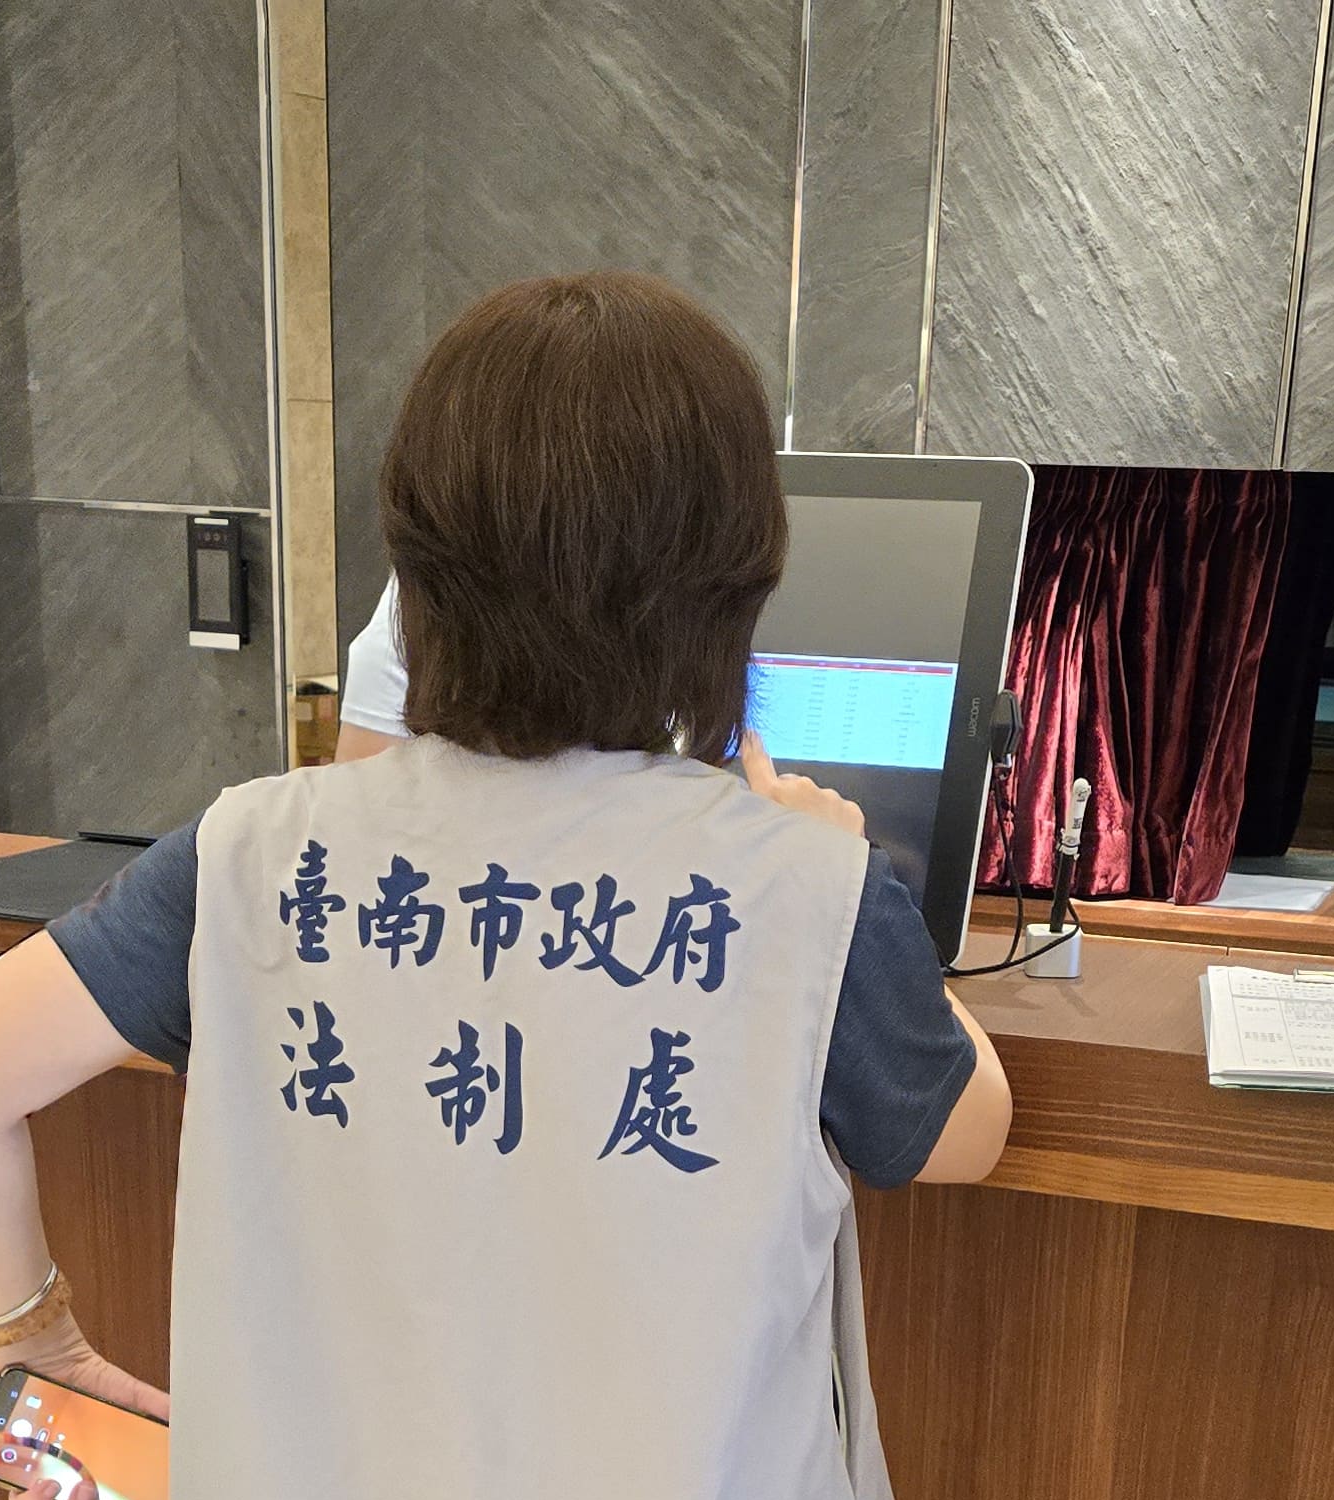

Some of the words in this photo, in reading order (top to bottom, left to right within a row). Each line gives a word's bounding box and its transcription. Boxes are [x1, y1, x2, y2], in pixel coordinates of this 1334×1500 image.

[967, 697, 981, 737] wacom
[279, 839, 742, 993] 臺南市政府
[279, 1000, 721, 1175] 法制處
